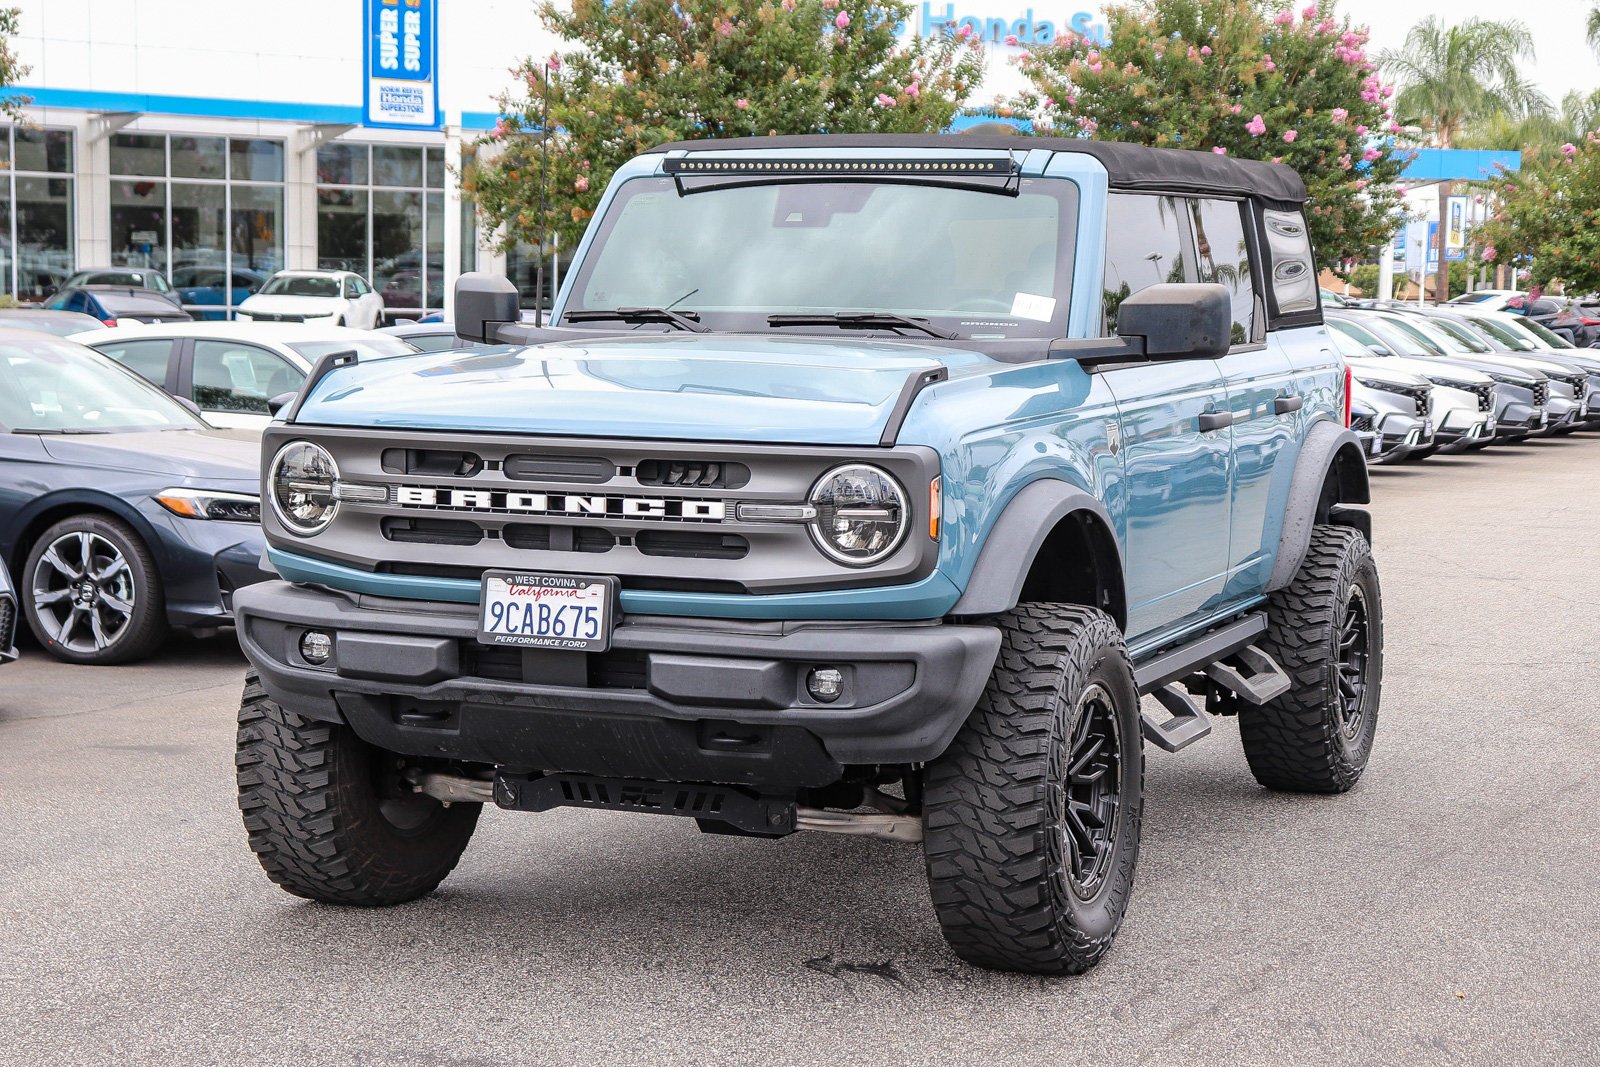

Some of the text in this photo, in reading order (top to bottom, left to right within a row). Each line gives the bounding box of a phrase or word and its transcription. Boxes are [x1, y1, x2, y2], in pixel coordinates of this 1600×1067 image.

[923, 1, 1056, 44] Honda
[380, 8, 398, 70] SUPER
[404, 10, 420, 71] SUPER
[380, 103, 424, 113] SUPERSTORE
[381, 93, 423, 104] Honda
[397, 486, 726, 520] BRONCO
[509, 584, 586, 602] California
[515, 575, 577, 588] WEST COVINA
[490, 600, 598, 638] 9CAB675
[494, 635, 588, 648] PERFORMANCE FORD
